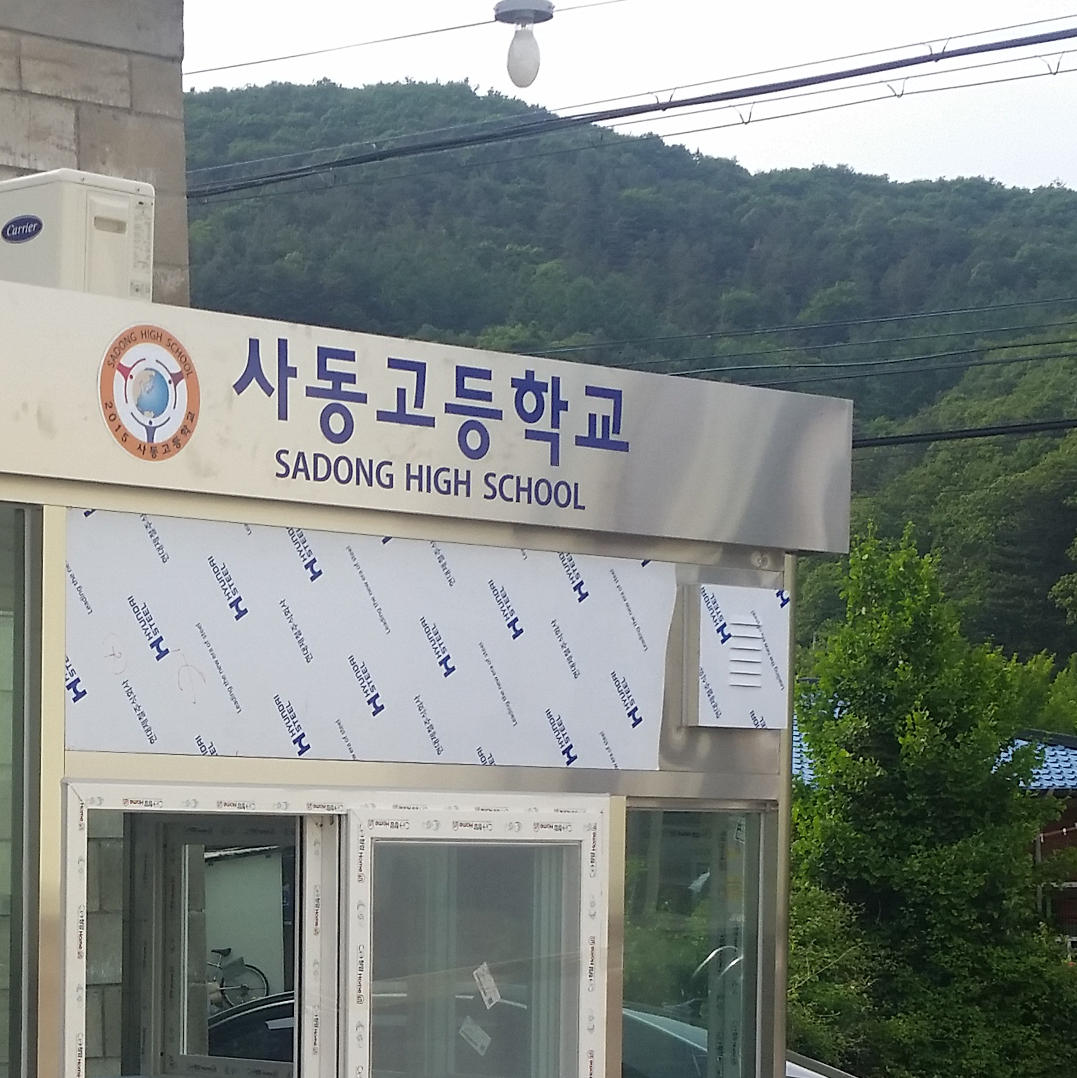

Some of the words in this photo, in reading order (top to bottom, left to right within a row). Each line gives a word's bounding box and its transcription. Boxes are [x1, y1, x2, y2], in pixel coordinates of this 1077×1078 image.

[6, 221, 38, 236] Carrier
[107, 332, 137, 368] SADONG
[140, 330, 163, 342] HIGH
[165, 338, 193, 377] SCHOOL
[233, 338, 629, 466] 사동고등학교
[104, 401, 129, 443] 2015
[137, 411, 195, 459] 사동고등학교
[275, 449, 394, 489] SADONG
[405, 462, 471, 497] HIGH
[483, 472, 586, 510] SCHOOL
[207, 555, 233, 601] HYUNDAI
[220, 562, 239, 597] STEEL
[127, 595, 153, 642] HYUNDAI
[141, 602, 160, 637] STEEL
[488, 579, 510, 622] HYUNDAI
[498, 586, 516, 617] STEEL
[700, 587, 720, 628] HYUNDAI
[710, 593, 724, 622] STEEL
[419, 616, 442, 660] HYUNDAI
[430, 622, 448, 655] STEEL
[348, 654, 370, 698] HYUNDAI
[359, 661, 376, 694] STEEL
[610, 670, 631, 712] HYUNDAI
[620, 676, 636, 707] STEEL
[273, 694, 296, 738] HYUNDAI
[286, 700, 302, 733] STEEL
[545, 708, 566, 750] HYUNDAI
[556, 714, 572, 745] STEEL
